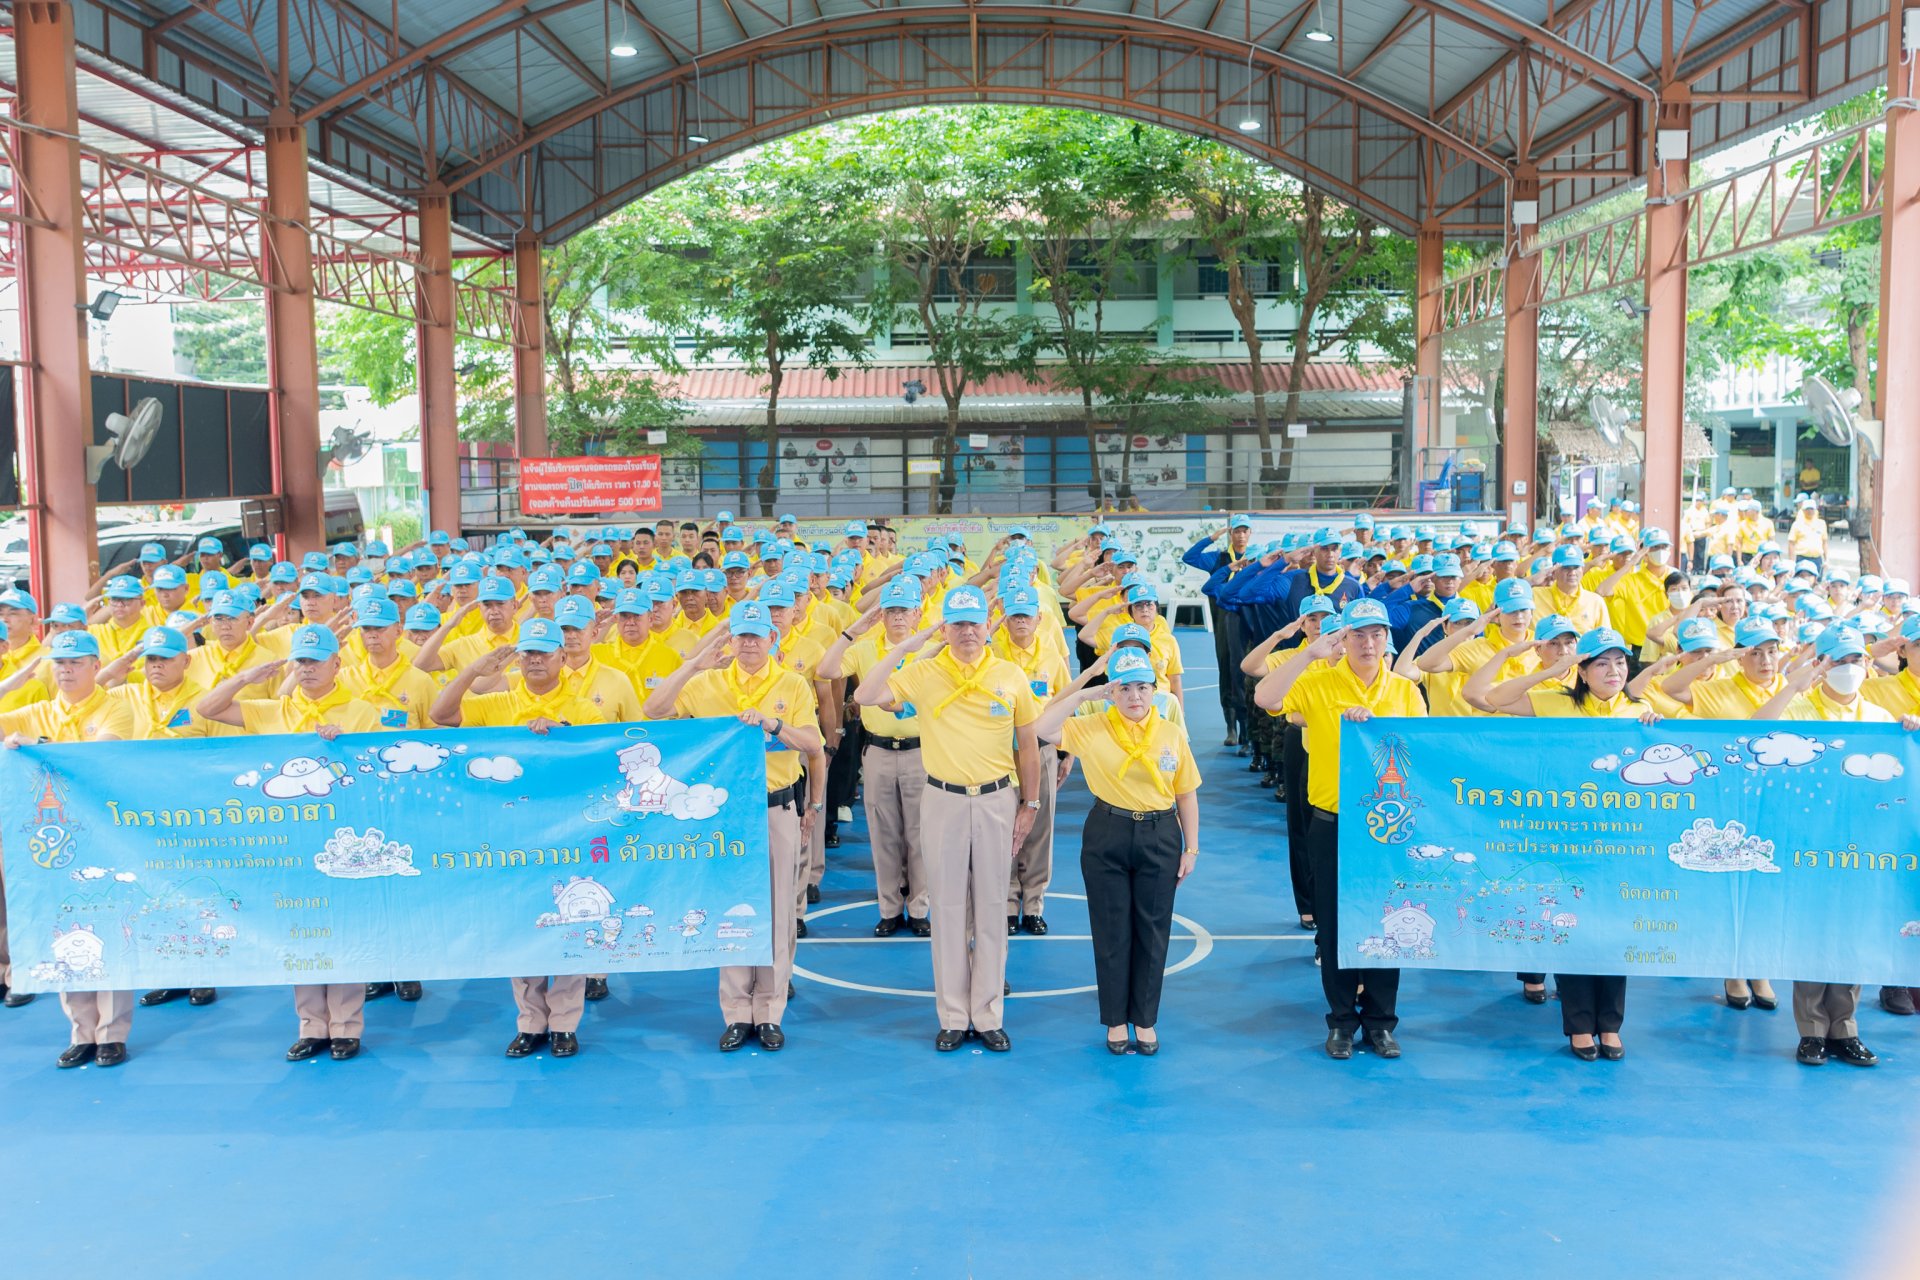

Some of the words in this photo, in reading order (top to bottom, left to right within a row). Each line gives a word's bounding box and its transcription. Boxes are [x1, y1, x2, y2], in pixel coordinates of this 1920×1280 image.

[618, 497, 633, 507] 500
[635, 496, 657, 508] บาท)
[1450, 778, 1697, 811] โครงการจิตอาสา
[105, 798, 337, 828] โครงการจิตอาสา
[1499, 813, 1643, 832] หน่วยพระราชทาน
[155, 831, 289, 849] หน่วยพระราชทาน
[1485, 836, 1656, 857] และประชาชนจิตอาสา
[431, 843, 582, 869] เราทำความ
[590, 836, 610, 863] ดี
[618, 831, 746, 862] ด้วยหัวใจ
[1792, 842, 1919, 871] เราทำคว
[145, 853, 303, 871] และประชาชนจิตอาสา
[271, 891, 330, 910] จิตอาสา
[1619, 881, 1679, 901] จิตอาสา
[289, 922, 332, 939] อำเภอ
[1633, 914, 1679, 932] อำเภอ
[283, 952, 334, 972] จังหวัด
[1624, 945, 1677, 964] จังหวัด
